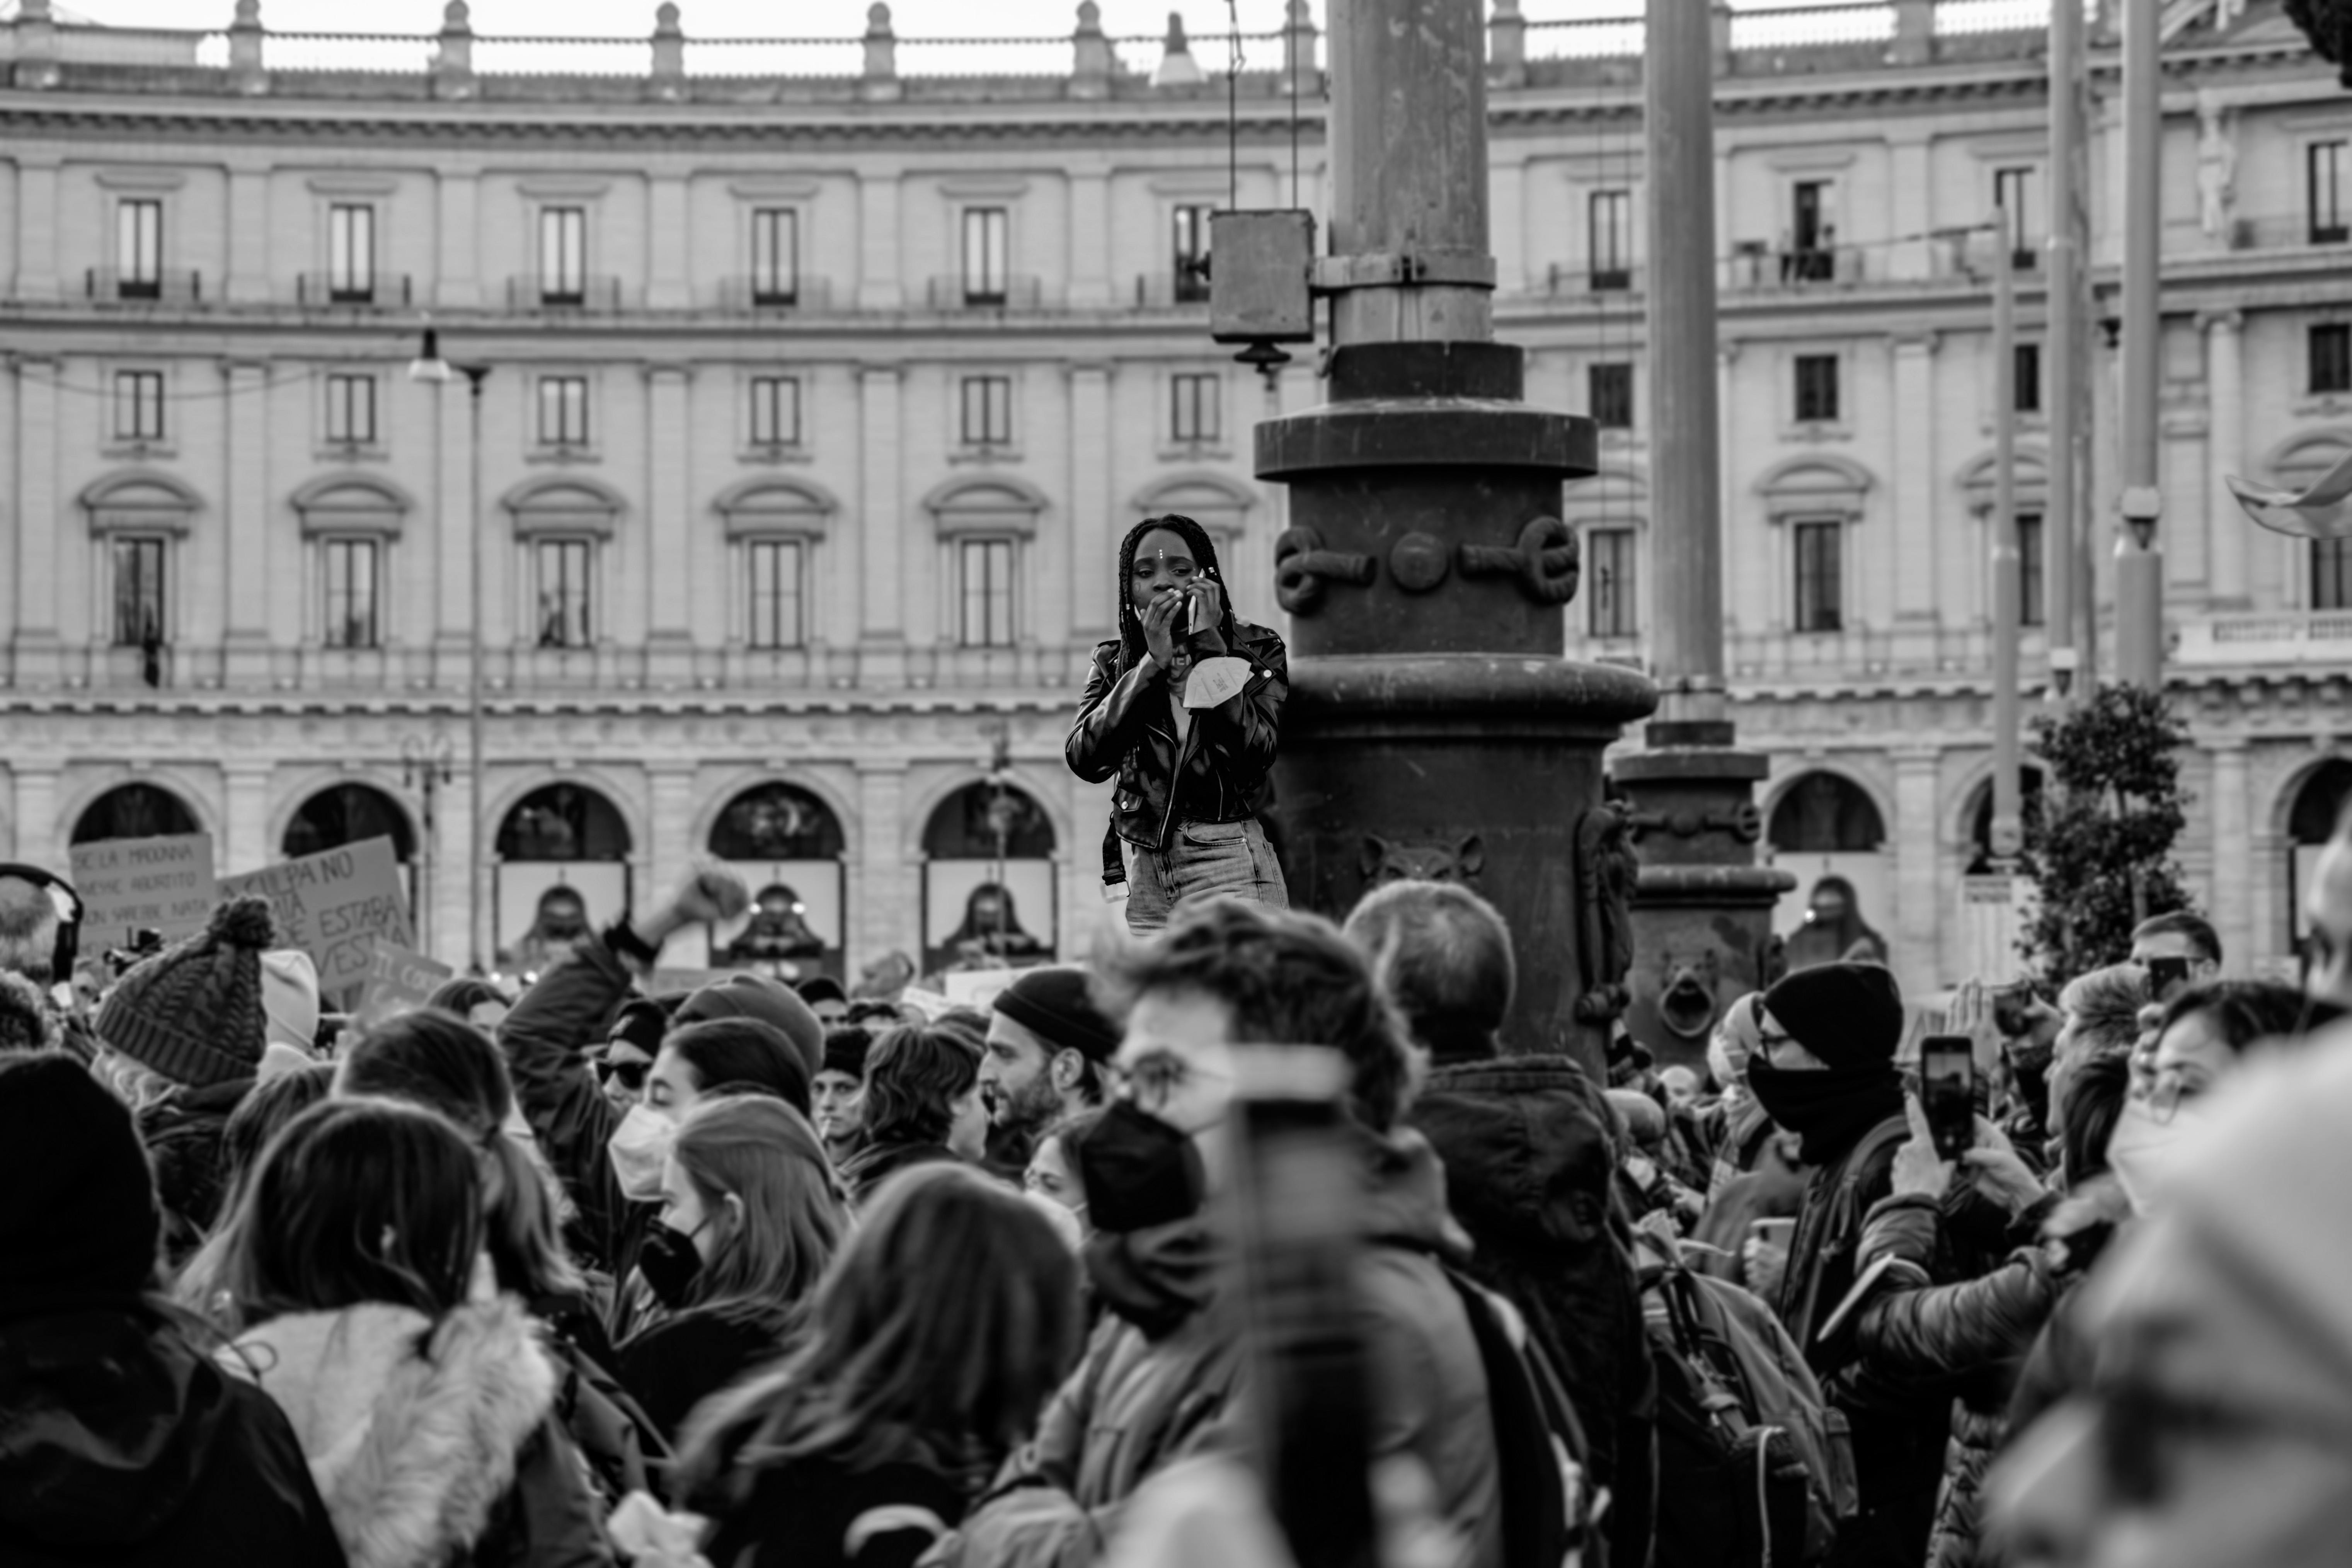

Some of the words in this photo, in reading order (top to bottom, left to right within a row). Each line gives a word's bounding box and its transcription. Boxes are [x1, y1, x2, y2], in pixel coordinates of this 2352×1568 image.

[99, 849, 118, 869] LA
[128, 843, 194, 865] MADONNA
[320, 850, 354, 884] NO
[131, 870, 197, 892] ABORTITO
[171, 898, 209, 916] NATA
[318, 894, 401, 938] ESTABA
